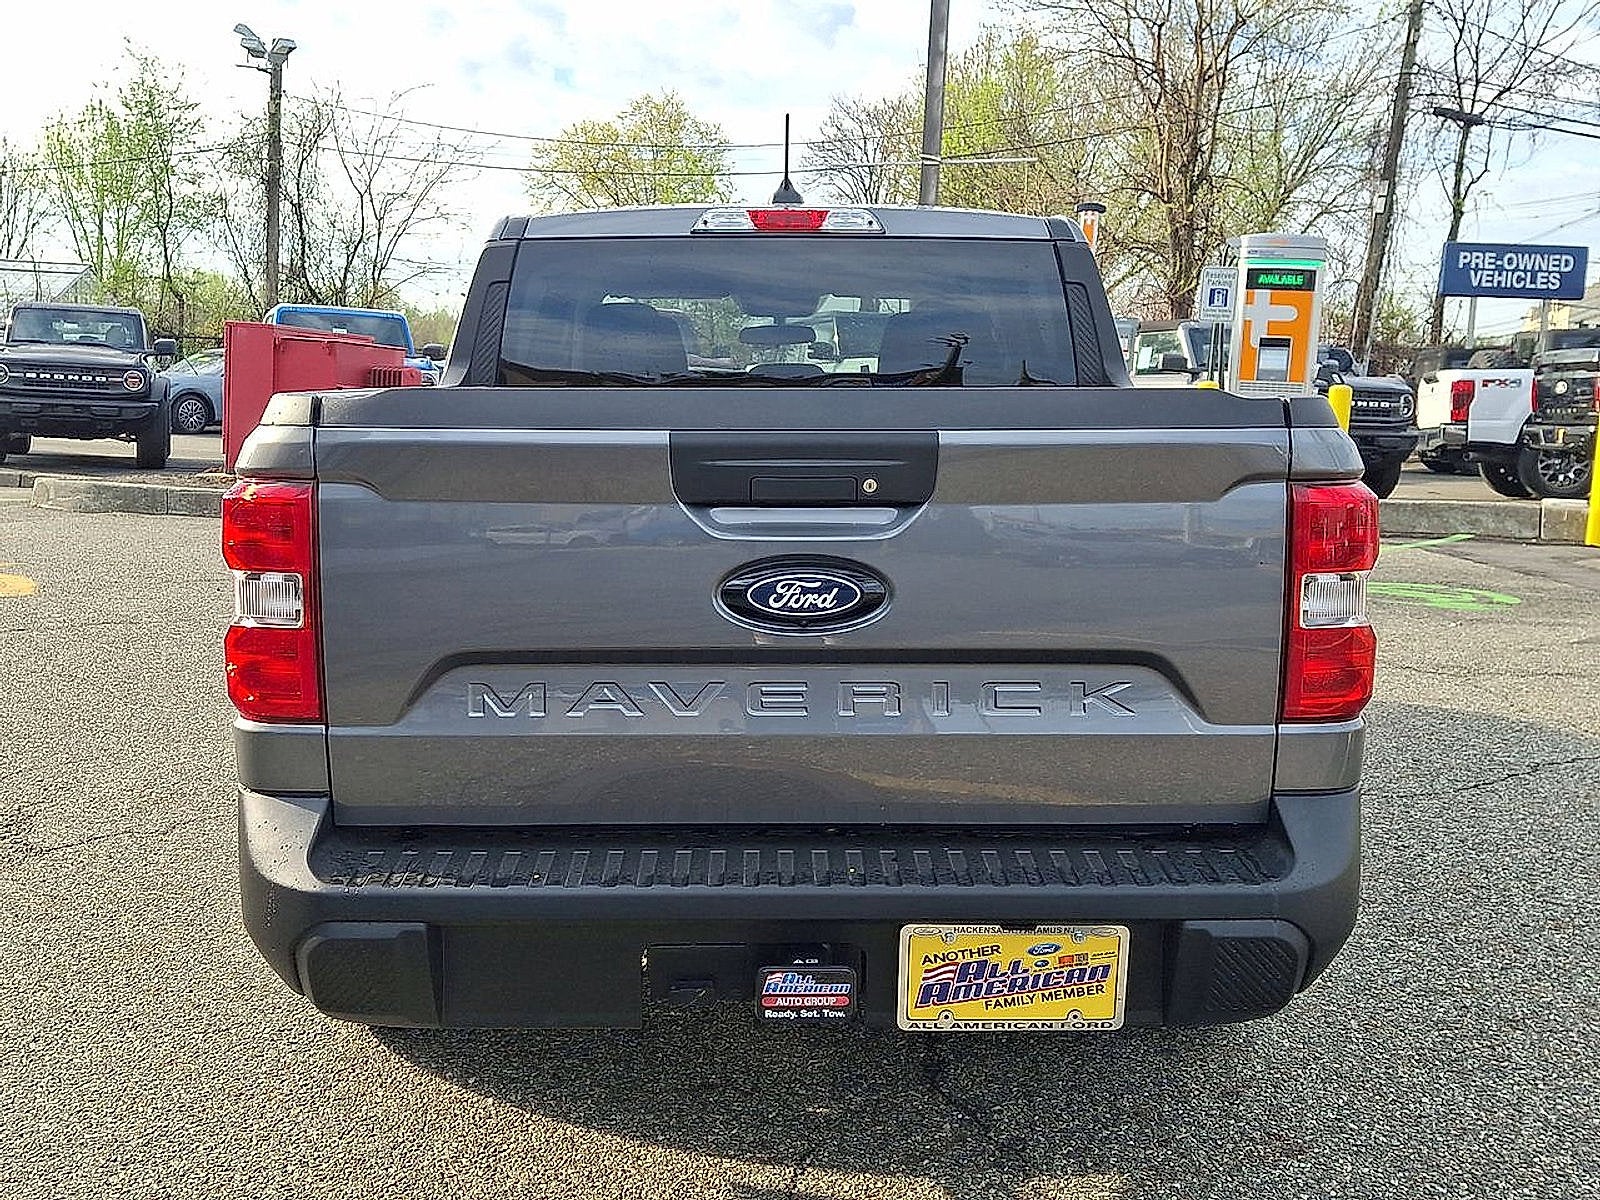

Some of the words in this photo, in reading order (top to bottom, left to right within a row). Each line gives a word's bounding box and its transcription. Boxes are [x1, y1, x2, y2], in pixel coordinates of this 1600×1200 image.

[1458, 251, 1575, 273] PRE-OWNED
[1258, 274, 1305, 285] AVAILABLE
[1470, 270, 1561, 290] VEHICLES
[768, 580, 840, 609] Ford
[467, 680, 1136, 718] MAVERICK
[921, 944, 1002, 966] ANOTHER
[776, 997, 802, 1007] AUTO
[803, 997, 837, 1007] GROUP
[984, 993, 1039, 1011] FAMILY
[1041, 984, 1106, 1003] MEMBER
[765, 1009, 798, 1020] Ready.
[800, 1009, 820, 1018] Set.
[822, 1009, 846, 1018] Tow.
[908, 1021, 944, 1029] ALL
[951, 1021, 1054, 1029] AMERICAN
[1060, 1021, 1114, 1029] FORD
